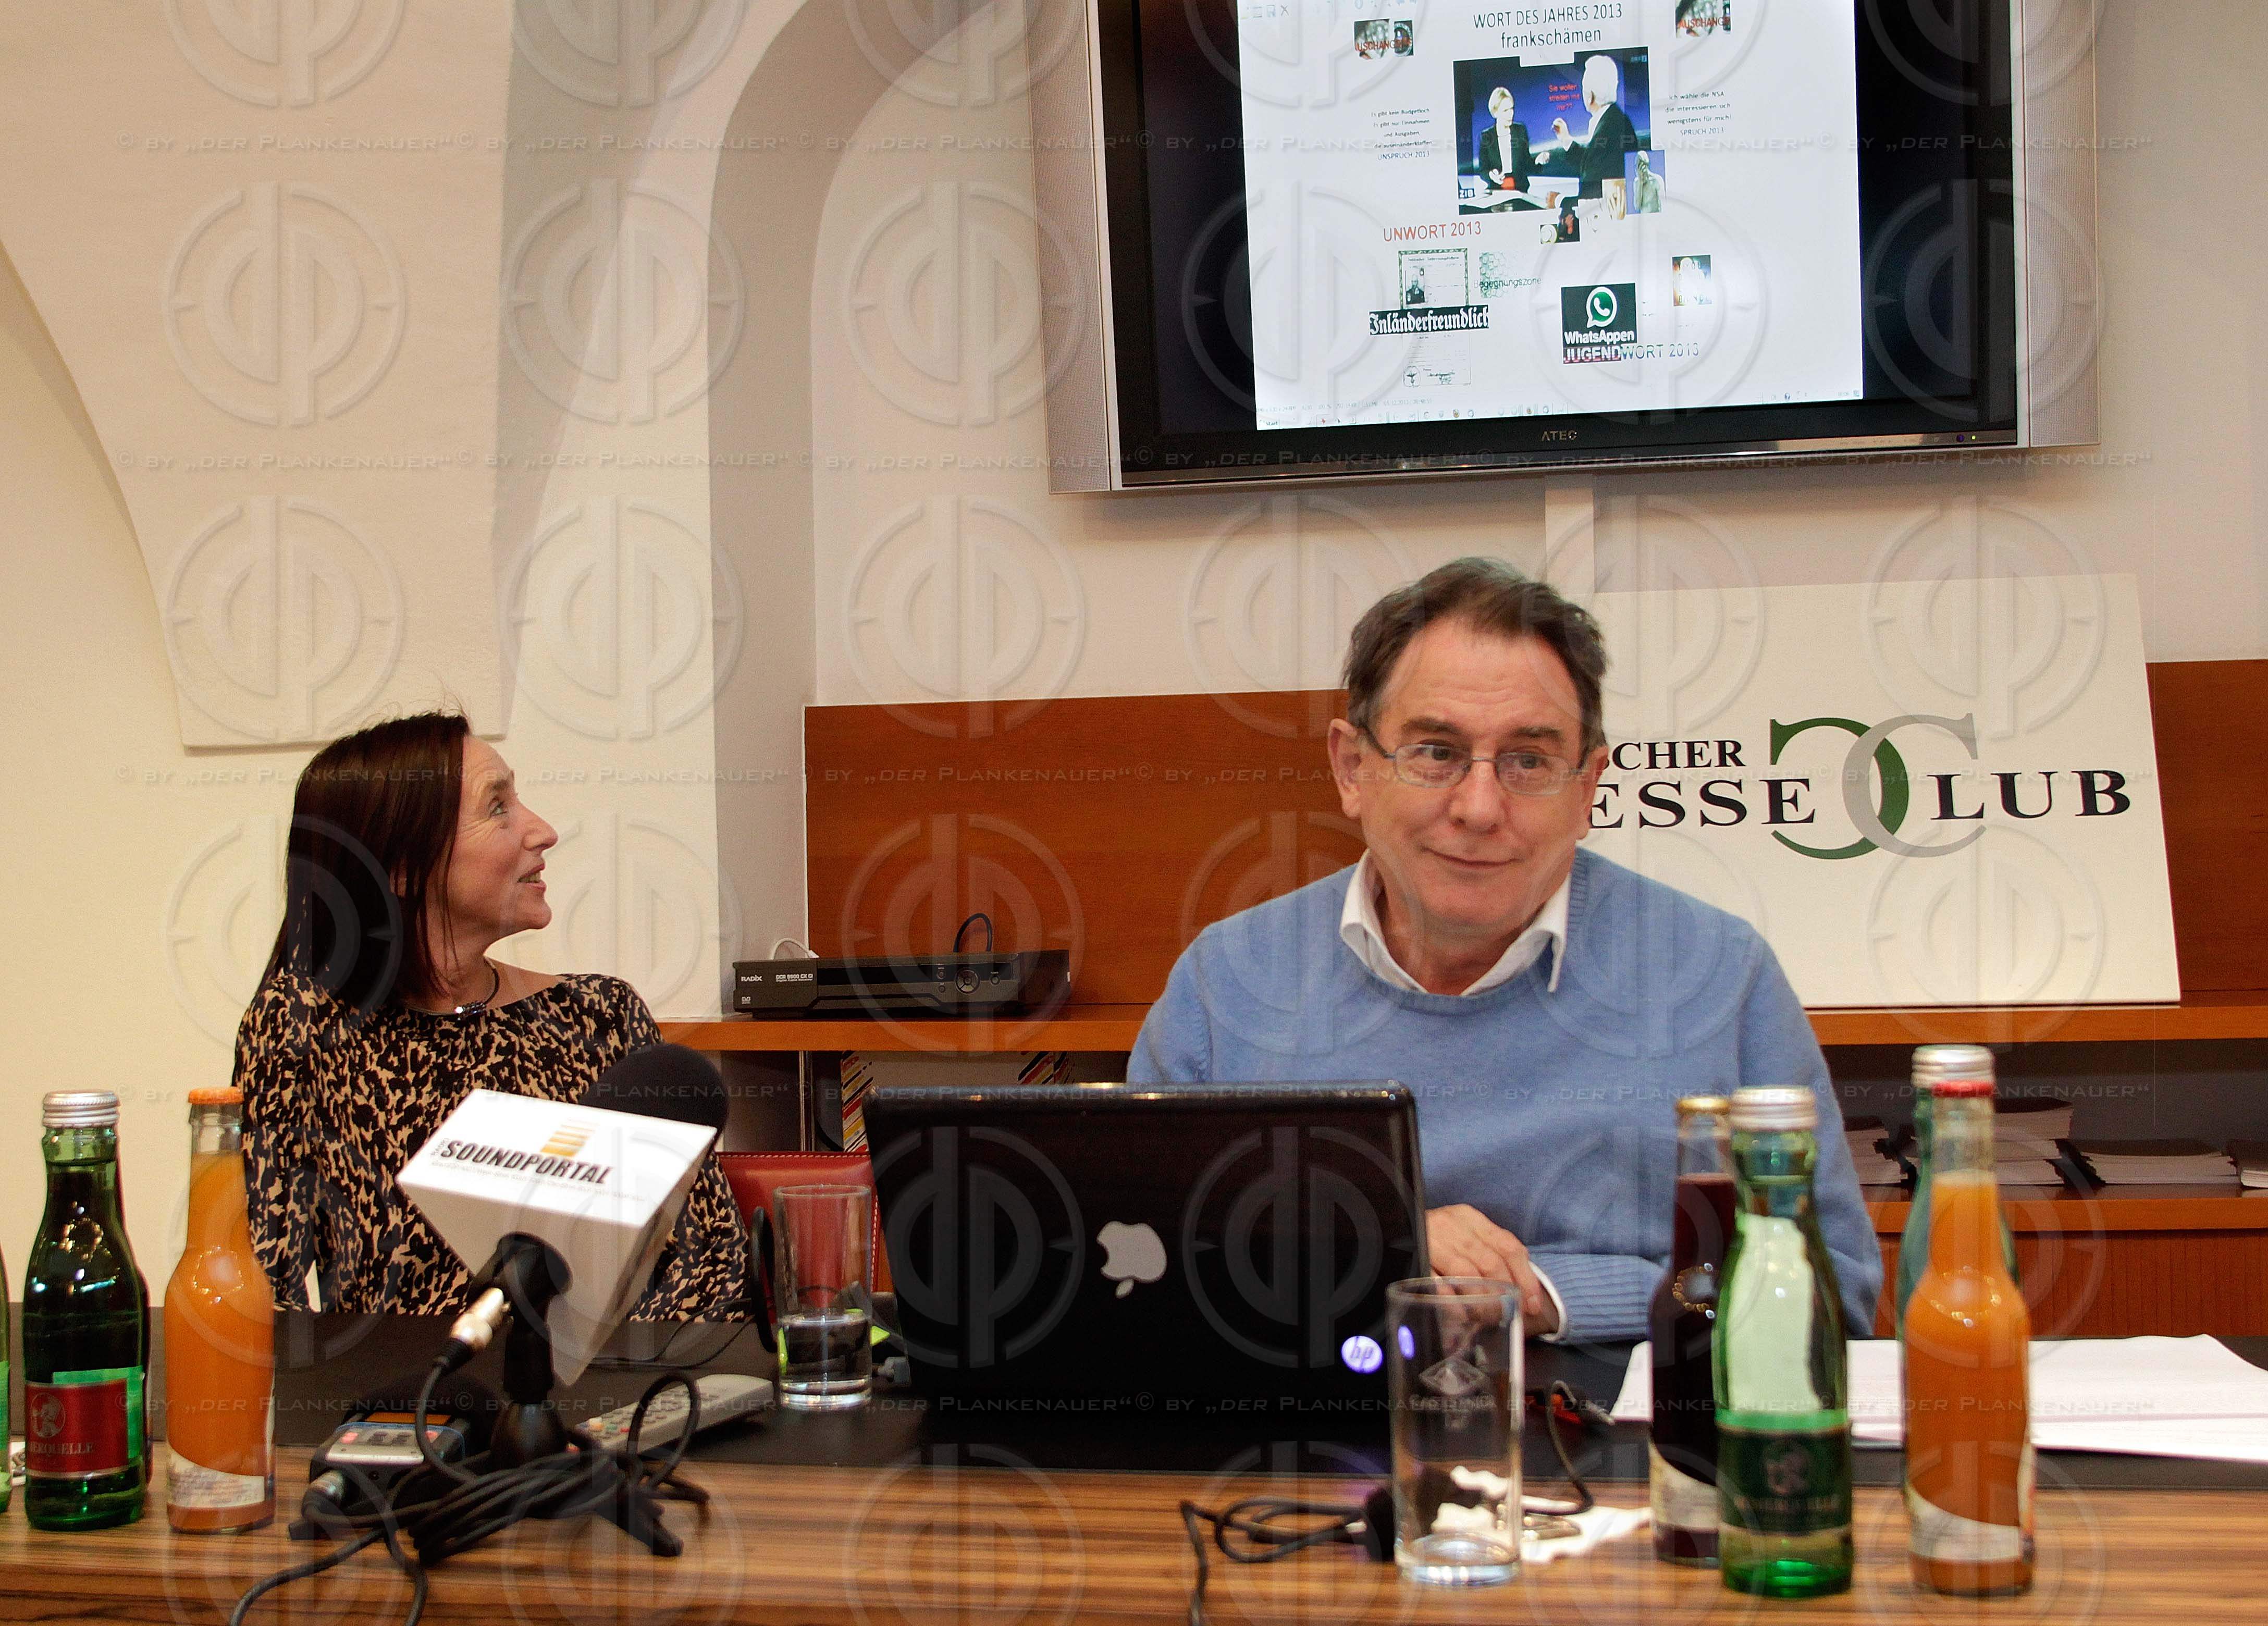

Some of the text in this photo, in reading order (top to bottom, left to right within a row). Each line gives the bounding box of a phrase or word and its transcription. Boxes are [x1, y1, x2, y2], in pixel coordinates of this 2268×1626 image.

[1473, 3, 1622, 29] WORT DES JAHRES 2013
[1501, 27, 1601, 49] frankschämen
[1667, 117, 1702, 125] wenigstens
[1680, 128, 1707, 136] SPRUCH
[1377, 152, 1413, 161] UNSPRUCH
[1383, 220, 1482, 242] UNWORT 2013
[1473, 277, 1542, 289] Begegnungszone
[1369, 305, 1489, 335] Inländerfreundlich
[1564, 329, 1635, 345] WhatsAppen
[1669, 342, 1699, 358] 2013
[1541, 430, 1577, 441] ATEC
[1605, 740, 1746, 770] CHER
[440, 1139, 614, 1185] SOUNDPORTAL
